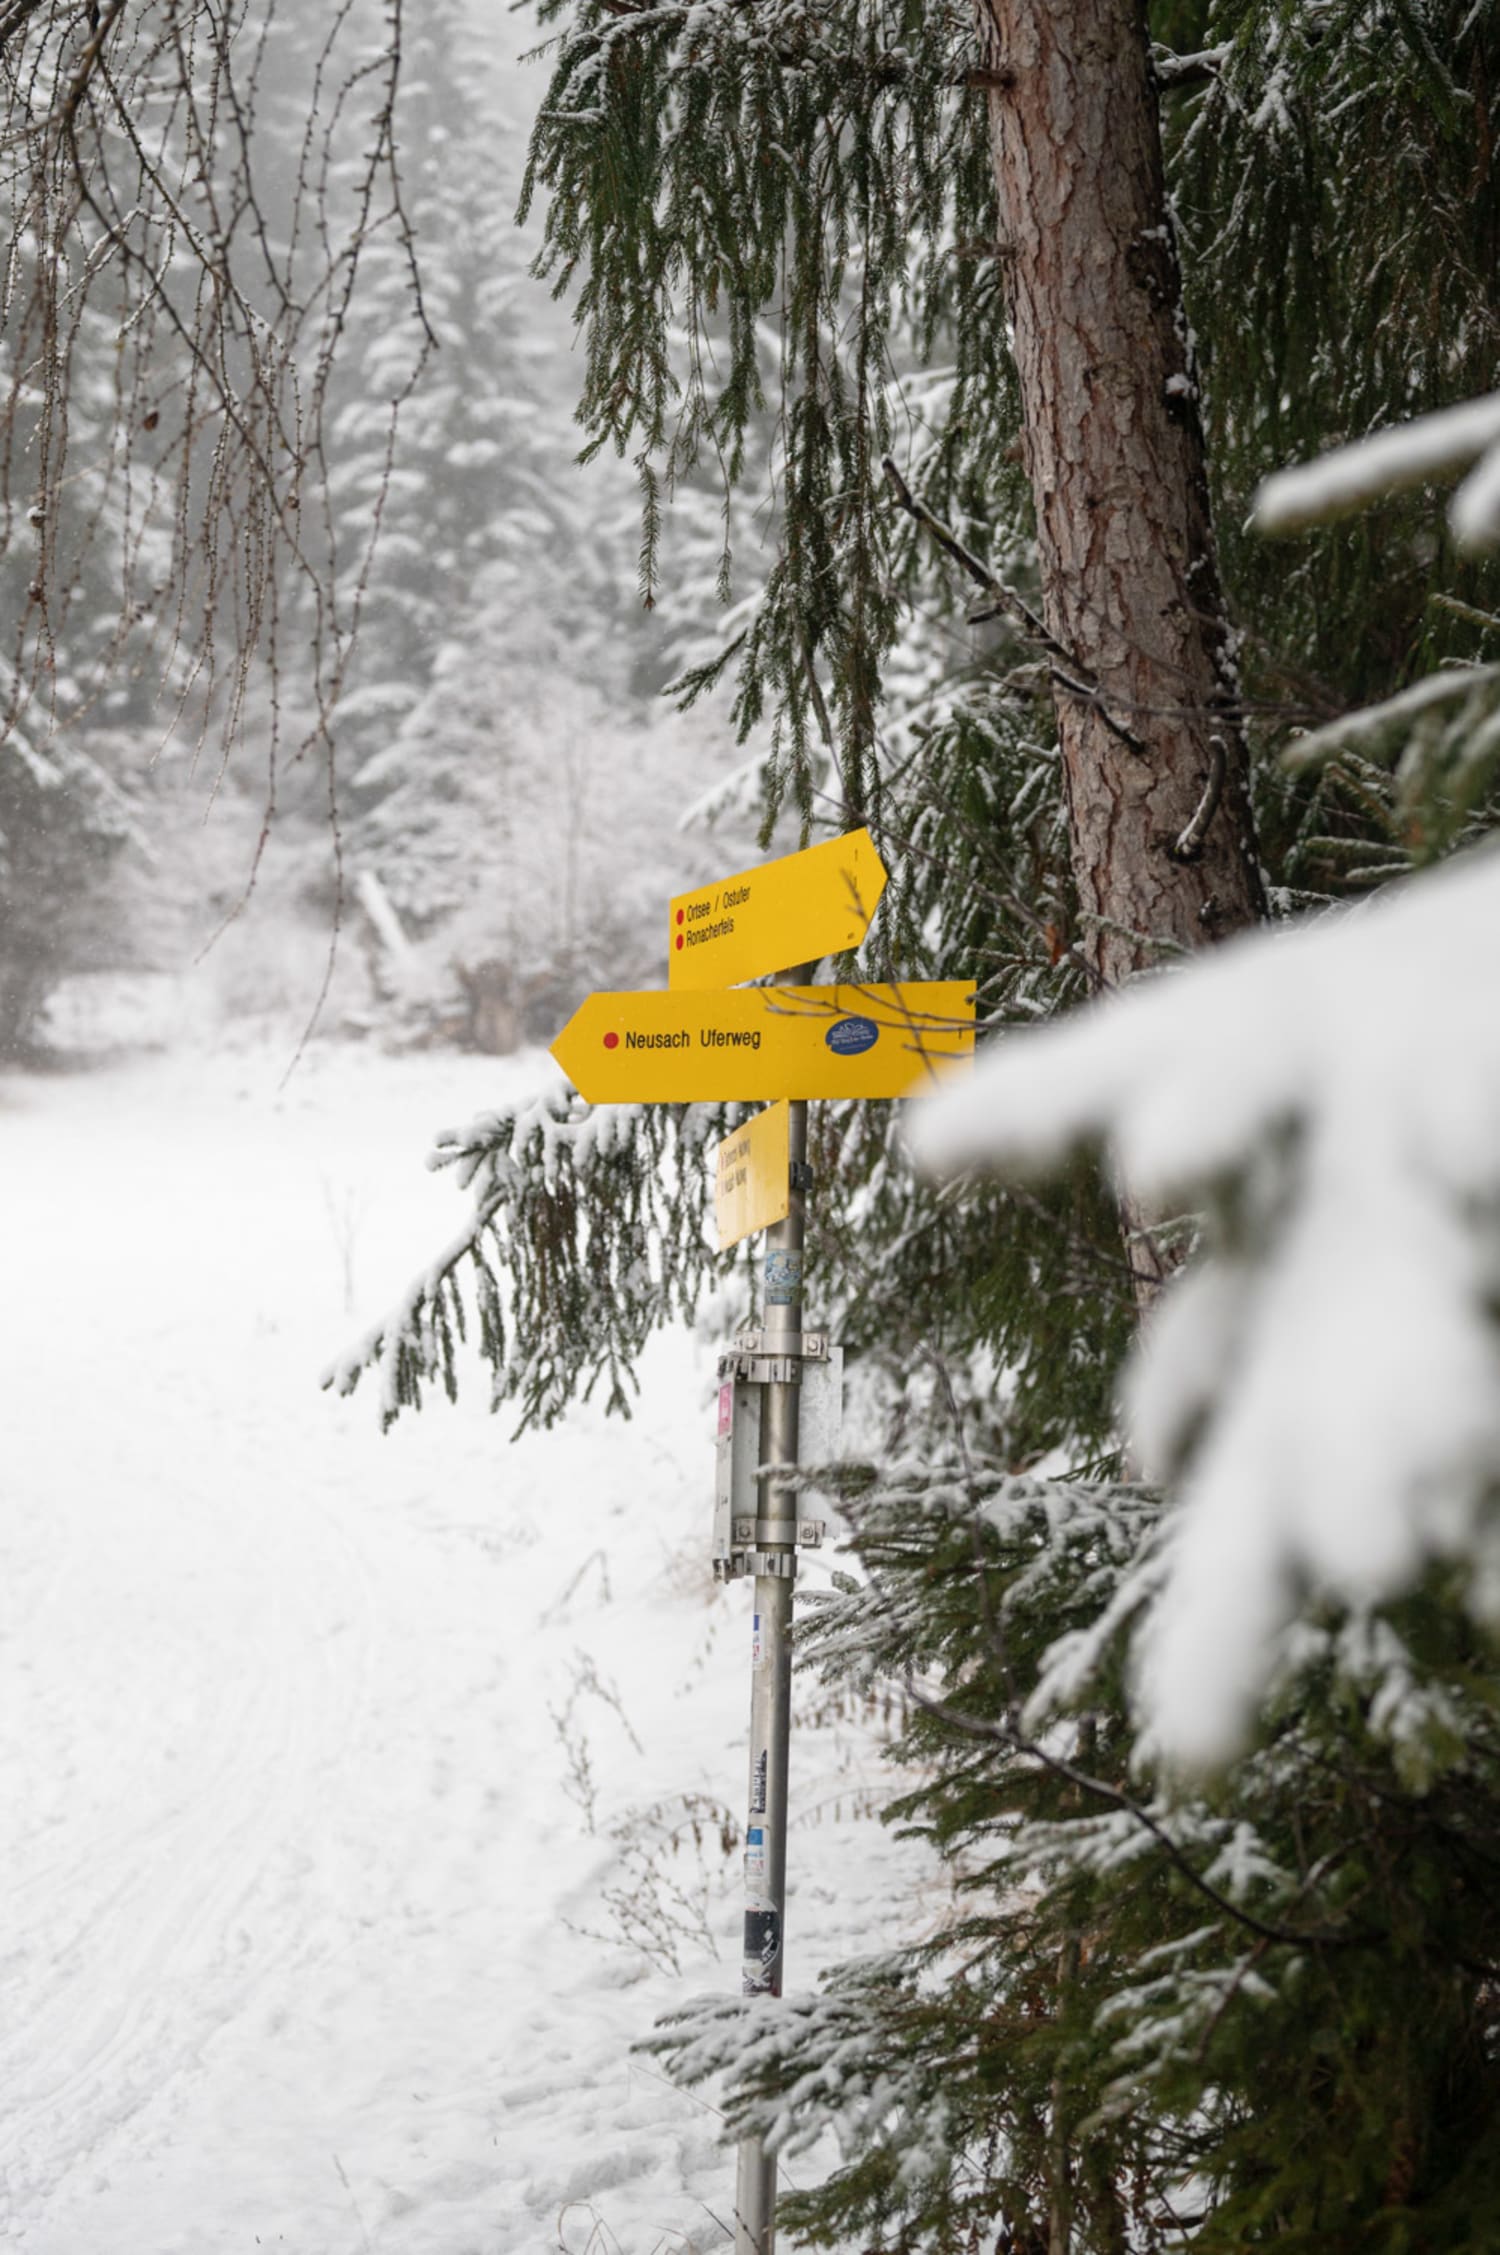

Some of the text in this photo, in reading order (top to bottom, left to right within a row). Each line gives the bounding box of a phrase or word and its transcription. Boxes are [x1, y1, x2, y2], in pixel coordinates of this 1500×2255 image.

[687, 902, 711, 922] Ortsee
[722, 886, 751, 909] Ostufer
[686, 917, 734, 948] Ronacherfels
[625, 1029, 762, 1050] Neusach Uferweg
